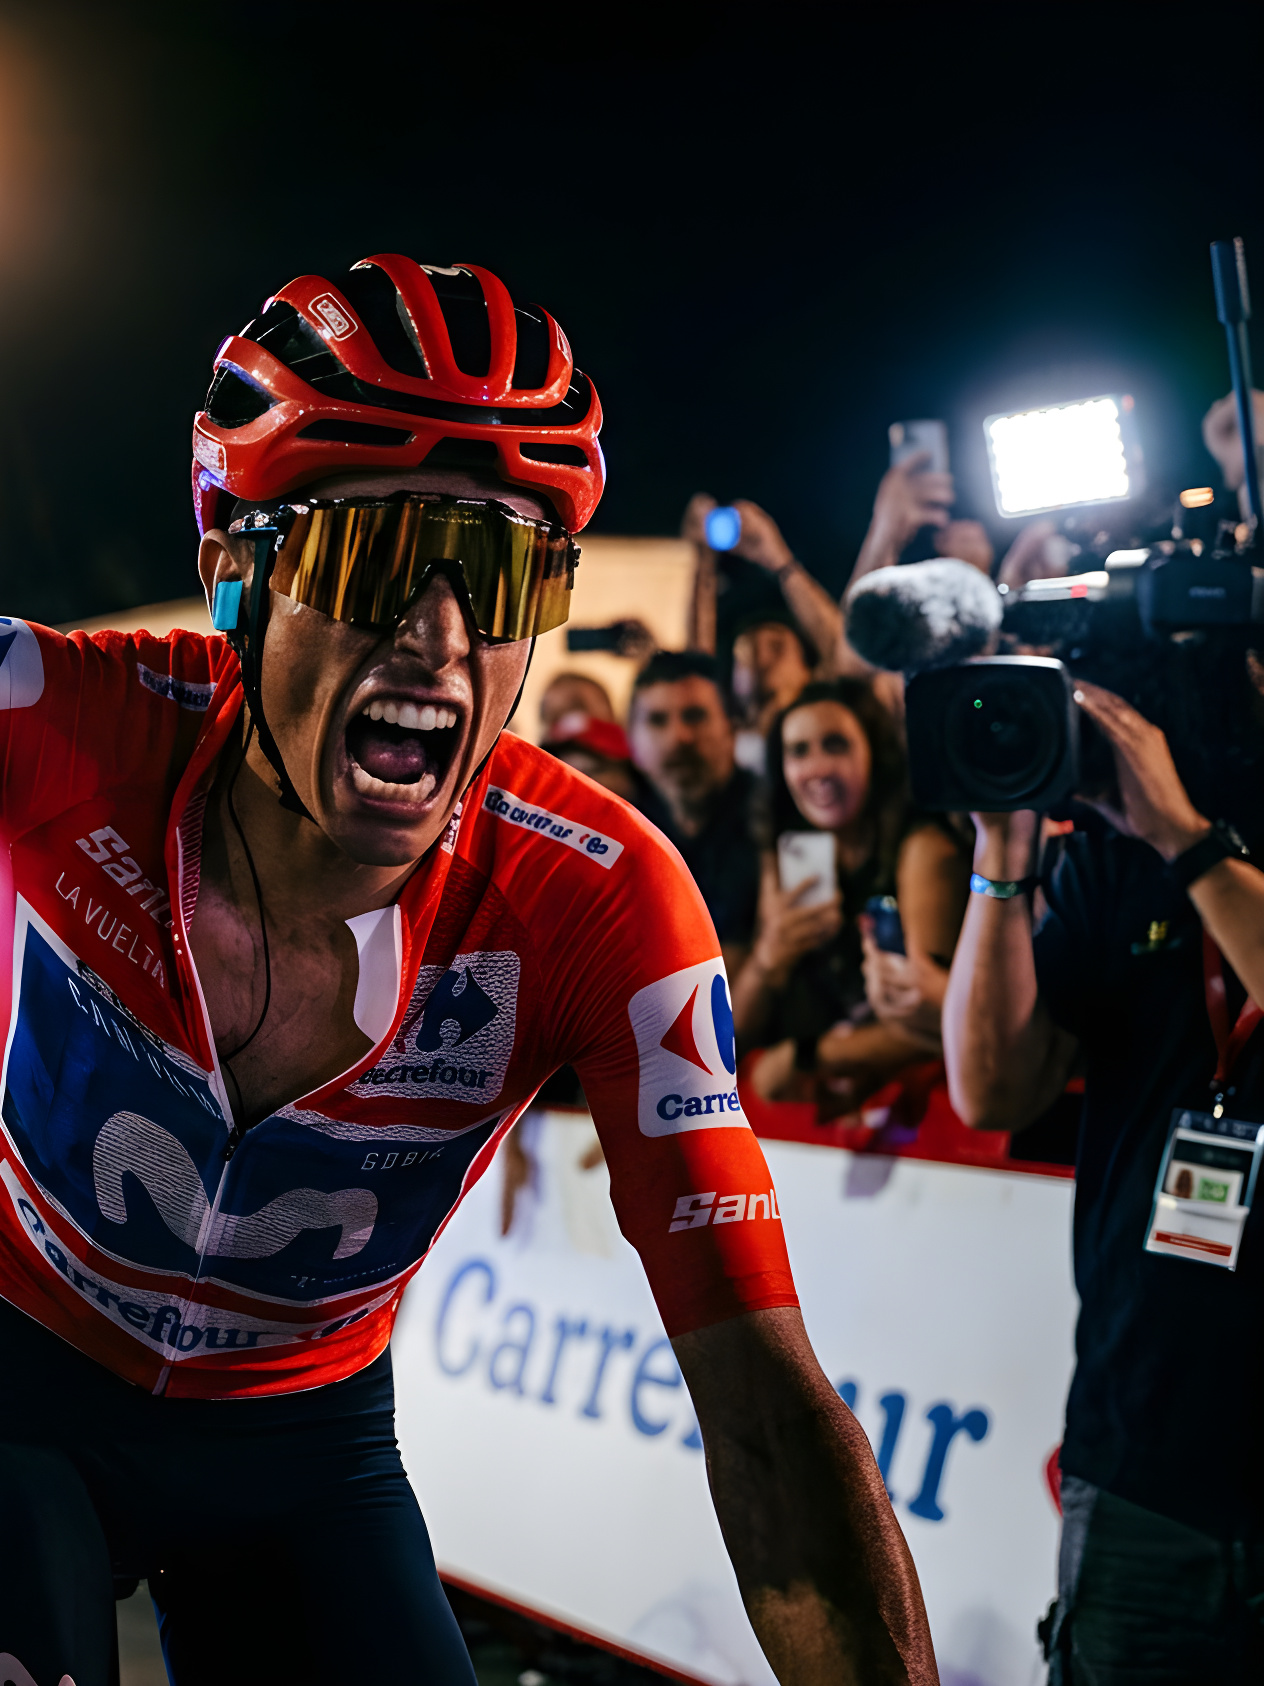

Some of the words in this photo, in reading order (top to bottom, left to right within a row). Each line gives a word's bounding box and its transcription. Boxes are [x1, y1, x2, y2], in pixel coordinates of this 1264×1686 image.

[55, 871, 81, 910] LA
[85, 897, 165, 989] VUELTA
[433, 1255, 992, 1523] Carreur
